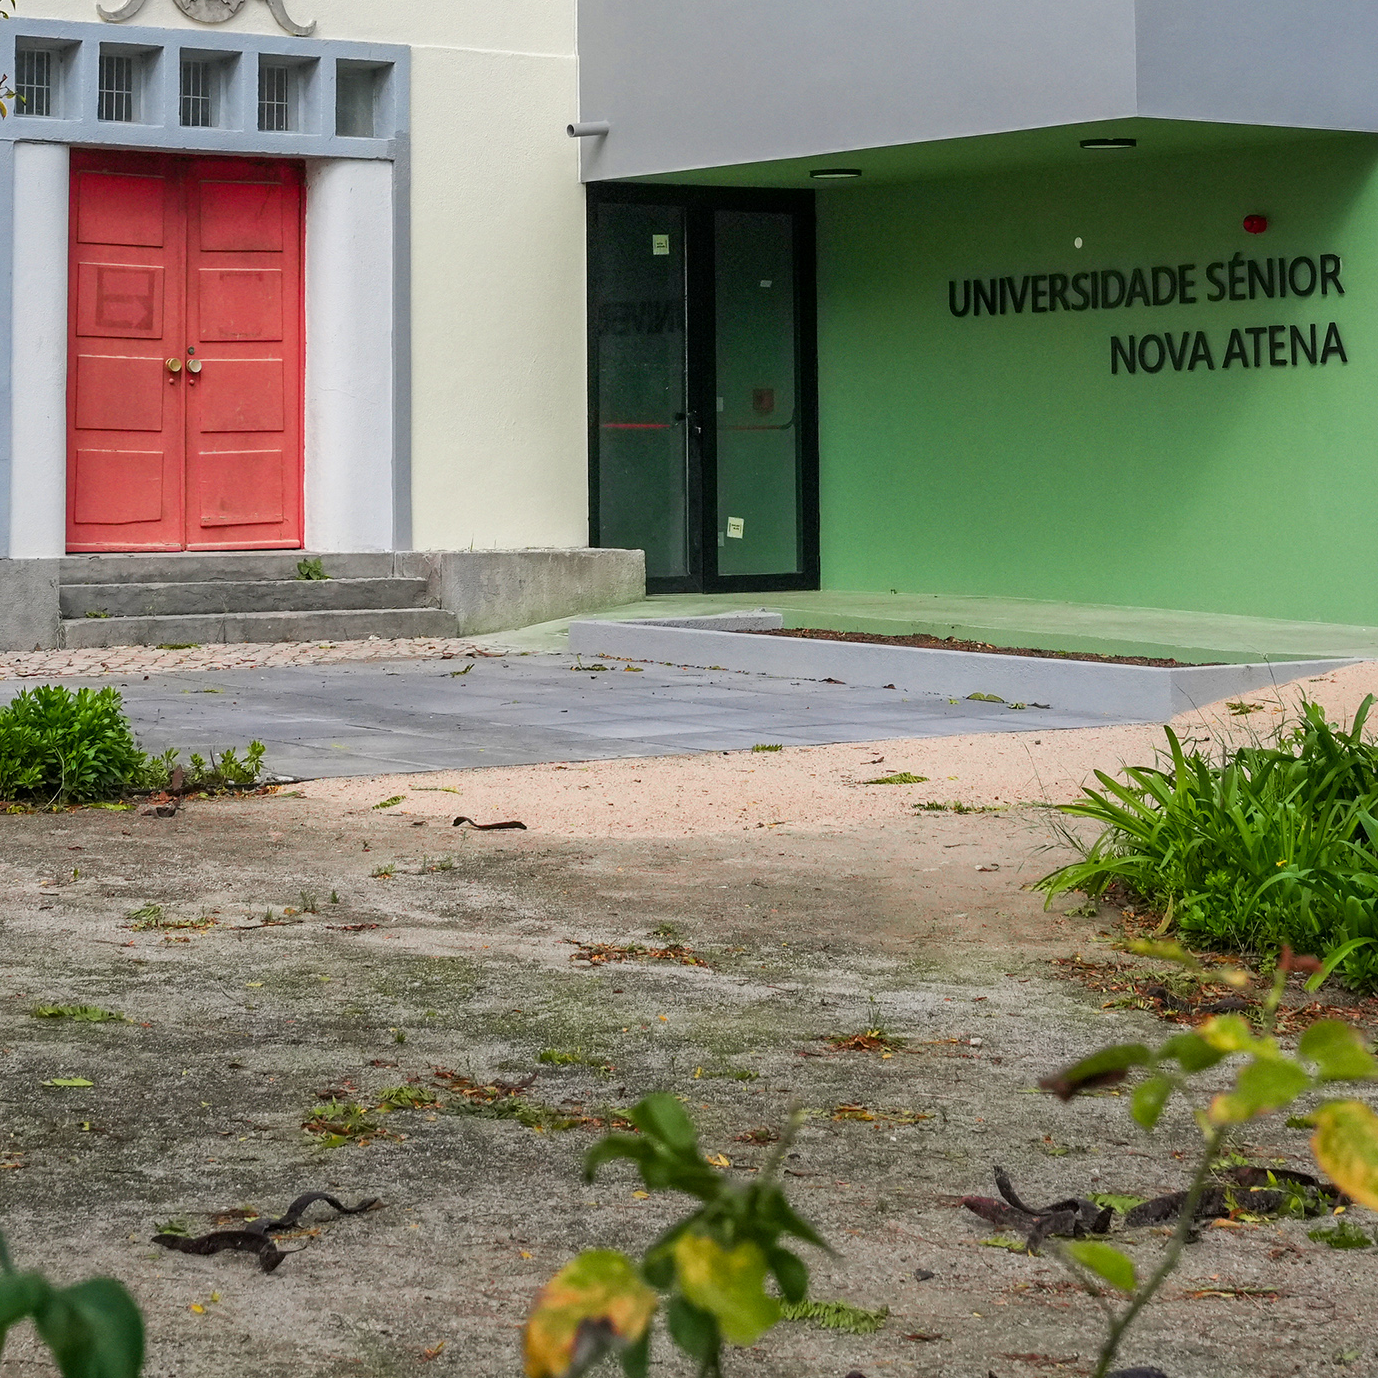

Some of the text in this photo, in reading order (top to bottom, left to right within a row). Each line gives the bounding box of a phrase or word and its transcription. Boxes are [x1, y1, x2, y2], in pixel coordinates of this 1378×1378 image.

[948, 252, 1345, 317] UNIVERSIDADE SÉNIOR
[1110, 321, 1348, 374] NOVA ATENA
